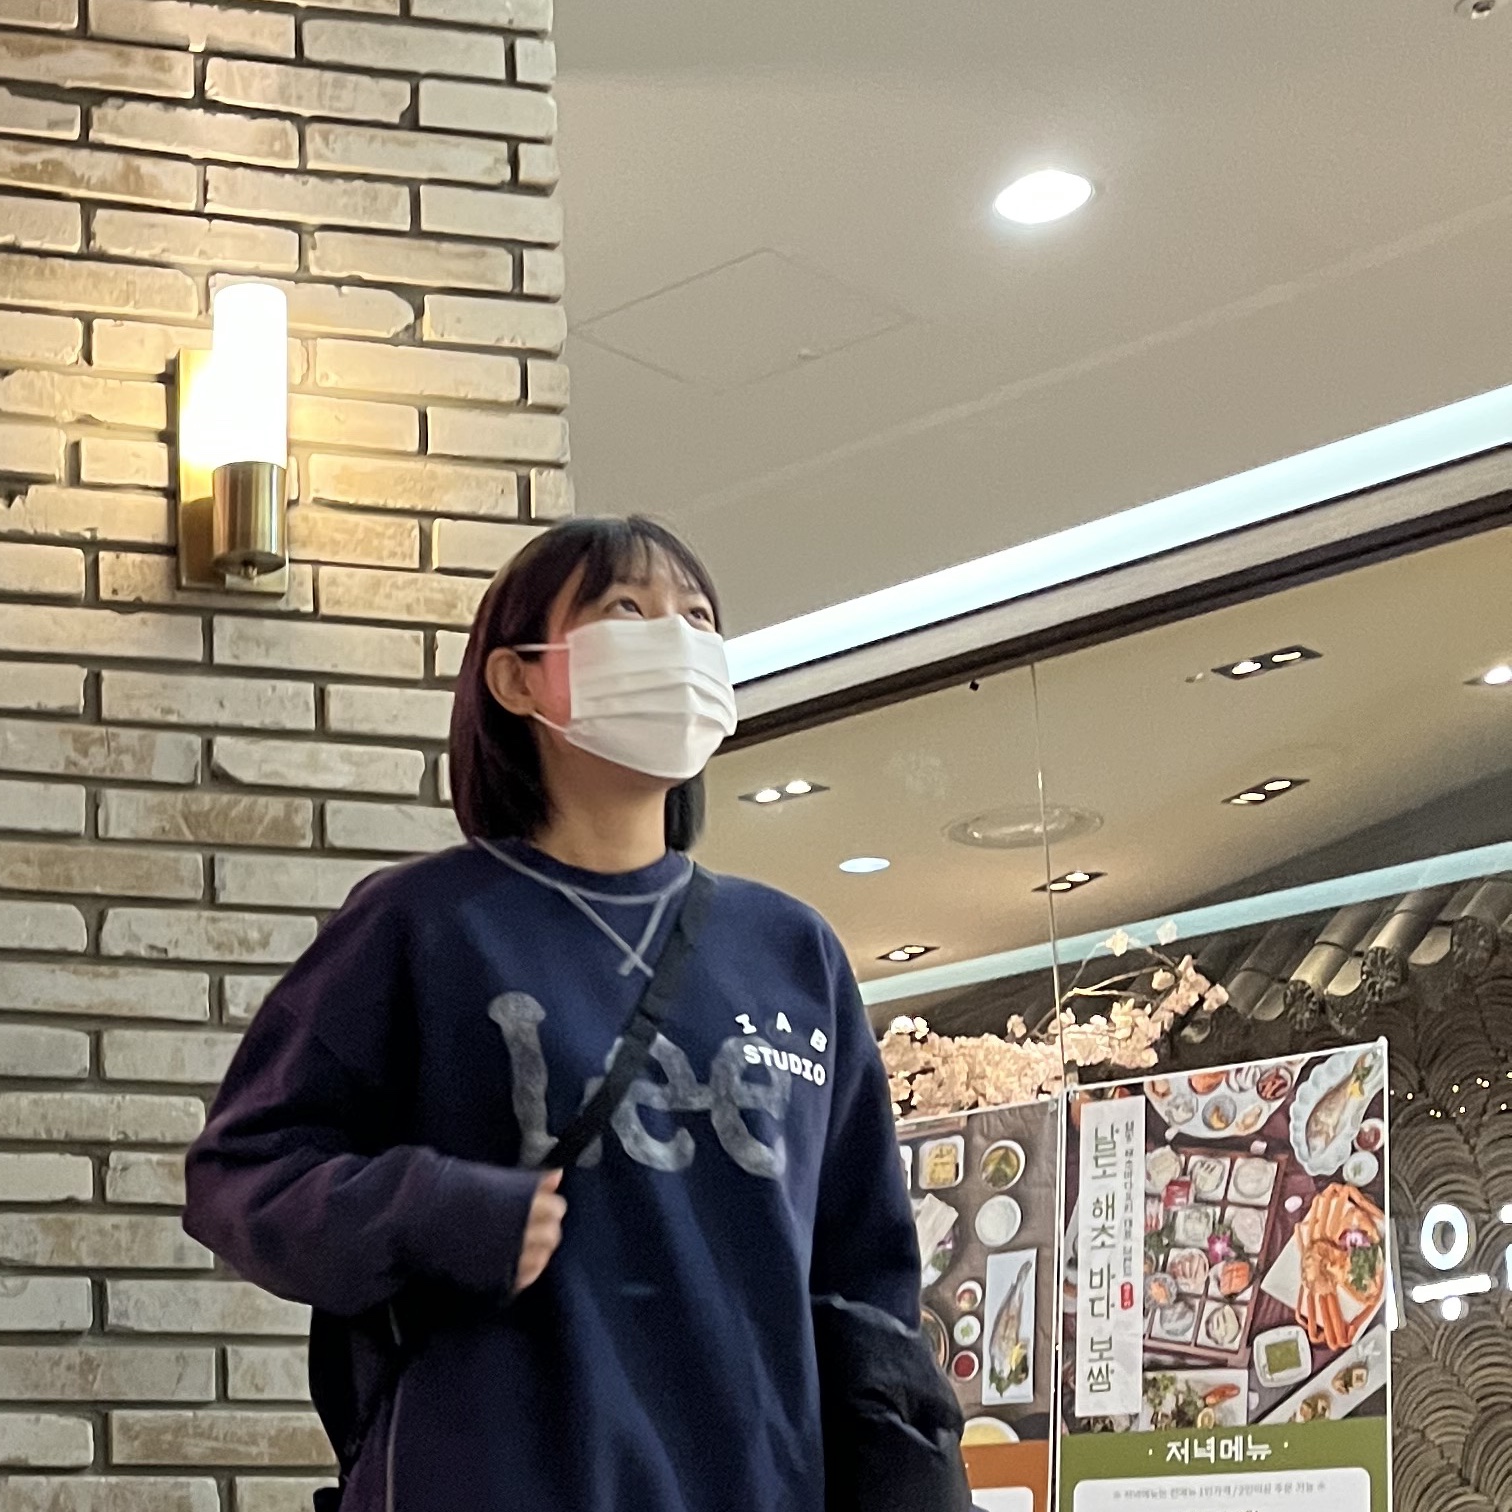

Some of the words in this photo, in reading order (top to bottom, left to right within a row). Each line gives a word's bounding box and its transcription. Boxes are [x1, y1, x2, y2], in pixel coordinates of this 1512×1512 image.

[742, 1043, 827, 1087] STUDIO
[1088, 1262, 1116, 1320] 바다
[1086, 1335, 1116, 1393] 보쌈
[1165, 1434, 1273, 1465] 저녁메뉴
